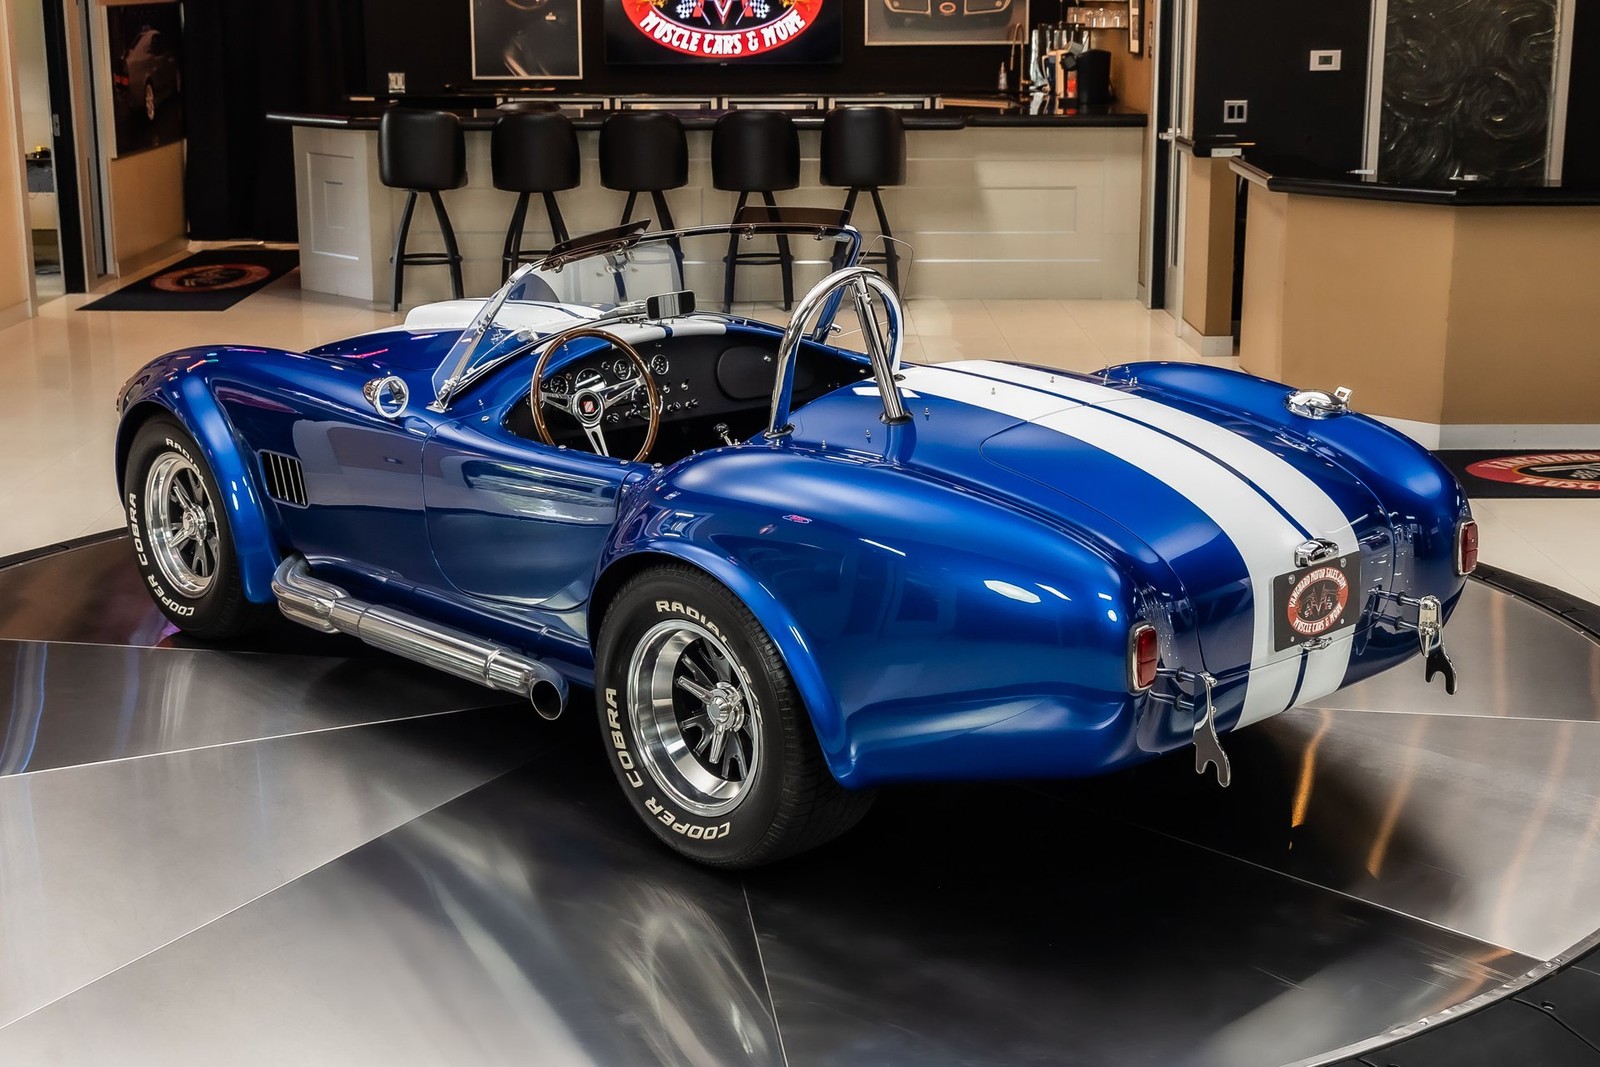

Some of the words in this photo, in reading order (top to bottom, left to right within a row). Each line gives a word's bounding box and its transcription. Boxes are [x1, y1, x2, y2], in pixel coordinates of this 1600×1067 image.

[639, 10, 701, 53] MUSCLE
[702, 32, 742, 55] CARS
[745, 31, 759, 52] &
[760, 9, 806, 48] MORE
[1478, 453, 1600, 470] VANGUARD
[1513, 476, 1600, 490] MUSC
[129, 492, 149, 567] COBRA
[147, 573, 195, 617] COOPER
[1289, 575, 1310, 608] VANGUARD
[1310, 568, 1326, 582] MOTOR
[1293, 617, 1312, 633] MUSCLE
[1312, 620, 1325, 633] CARS
[1325, 616, 1330, 627] &
[1330, 602, 1344, 625] MORE
[605, 687, 643, 789] COBRA
[644, 796, 732, 840] COOPER
